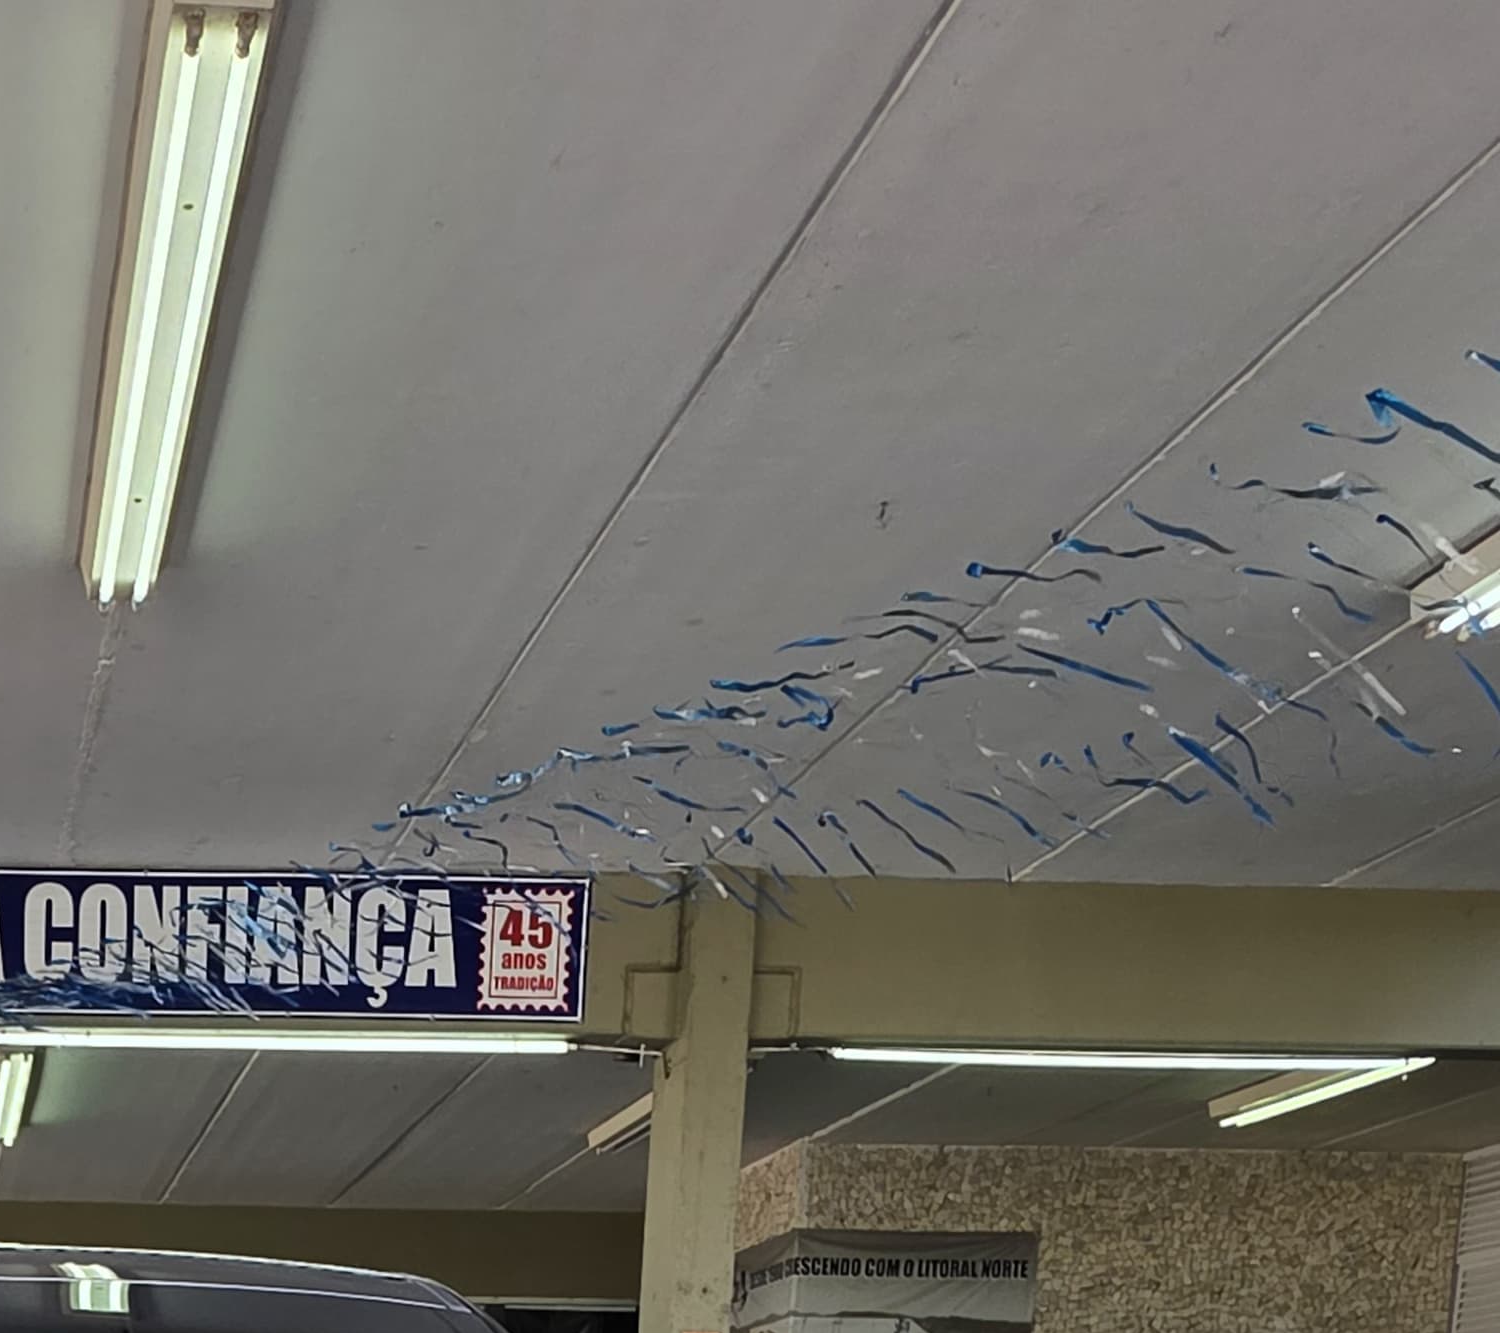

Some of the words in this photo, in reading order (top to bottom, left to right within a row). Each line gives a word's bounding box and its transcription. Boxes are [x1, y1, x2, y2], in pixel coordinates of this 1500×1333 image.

[499, 909, 553, 949] 45
[23, 881, 456, 1008] CONFIANÇA
[501, 952, 547, 970] anos
[493, 974, 554, 992] TRADIÇÃO
[864, 1258, 900, 1278] COM
[903, 1259, 915, 1278] O
[917, 1259, 978, 1279] LITORAL
[981, 1259, 1029, 1280] NORTE
